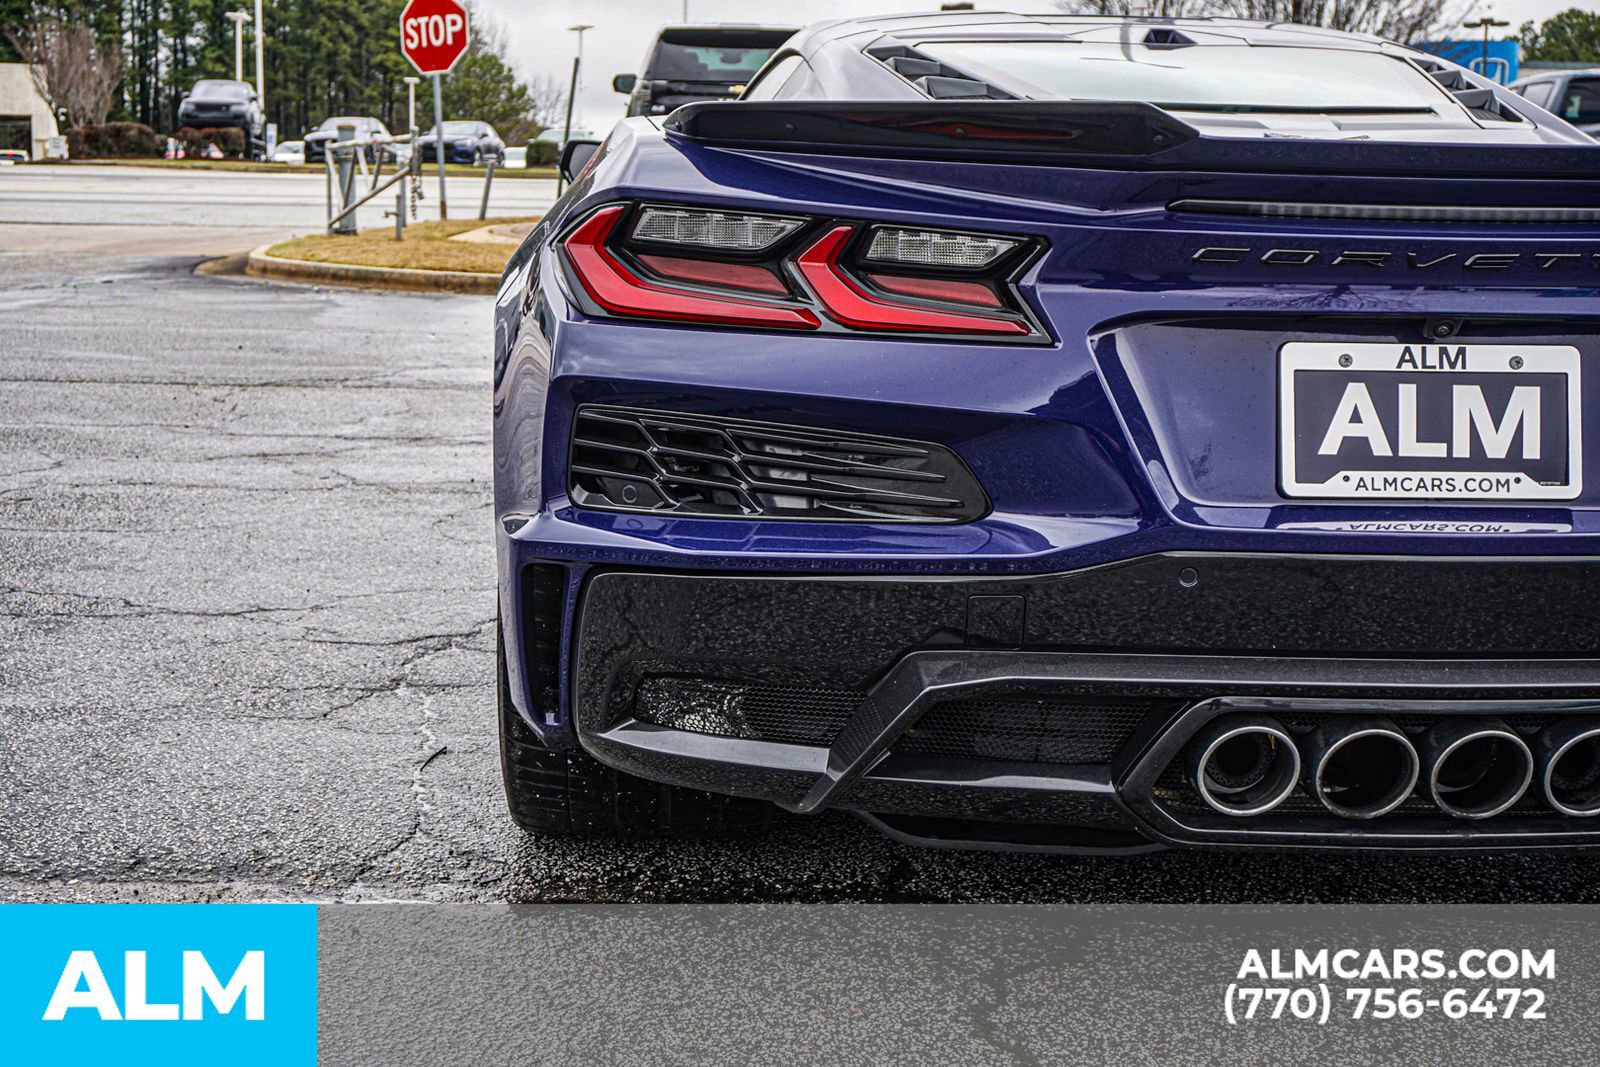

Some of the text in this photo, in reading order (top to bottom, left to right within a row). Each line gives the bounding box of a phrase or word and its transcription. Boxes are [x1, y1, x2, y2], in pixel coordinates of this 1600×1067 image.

[405, 13, 463, 50] STOP
[1191, 247, 1600, 270] CORVET
[1396, 344, 1468, 370] ALM
[1317, 382, 1541, 460] ALM
[1355, 476, 1511, 493] ALMCARS.COM
